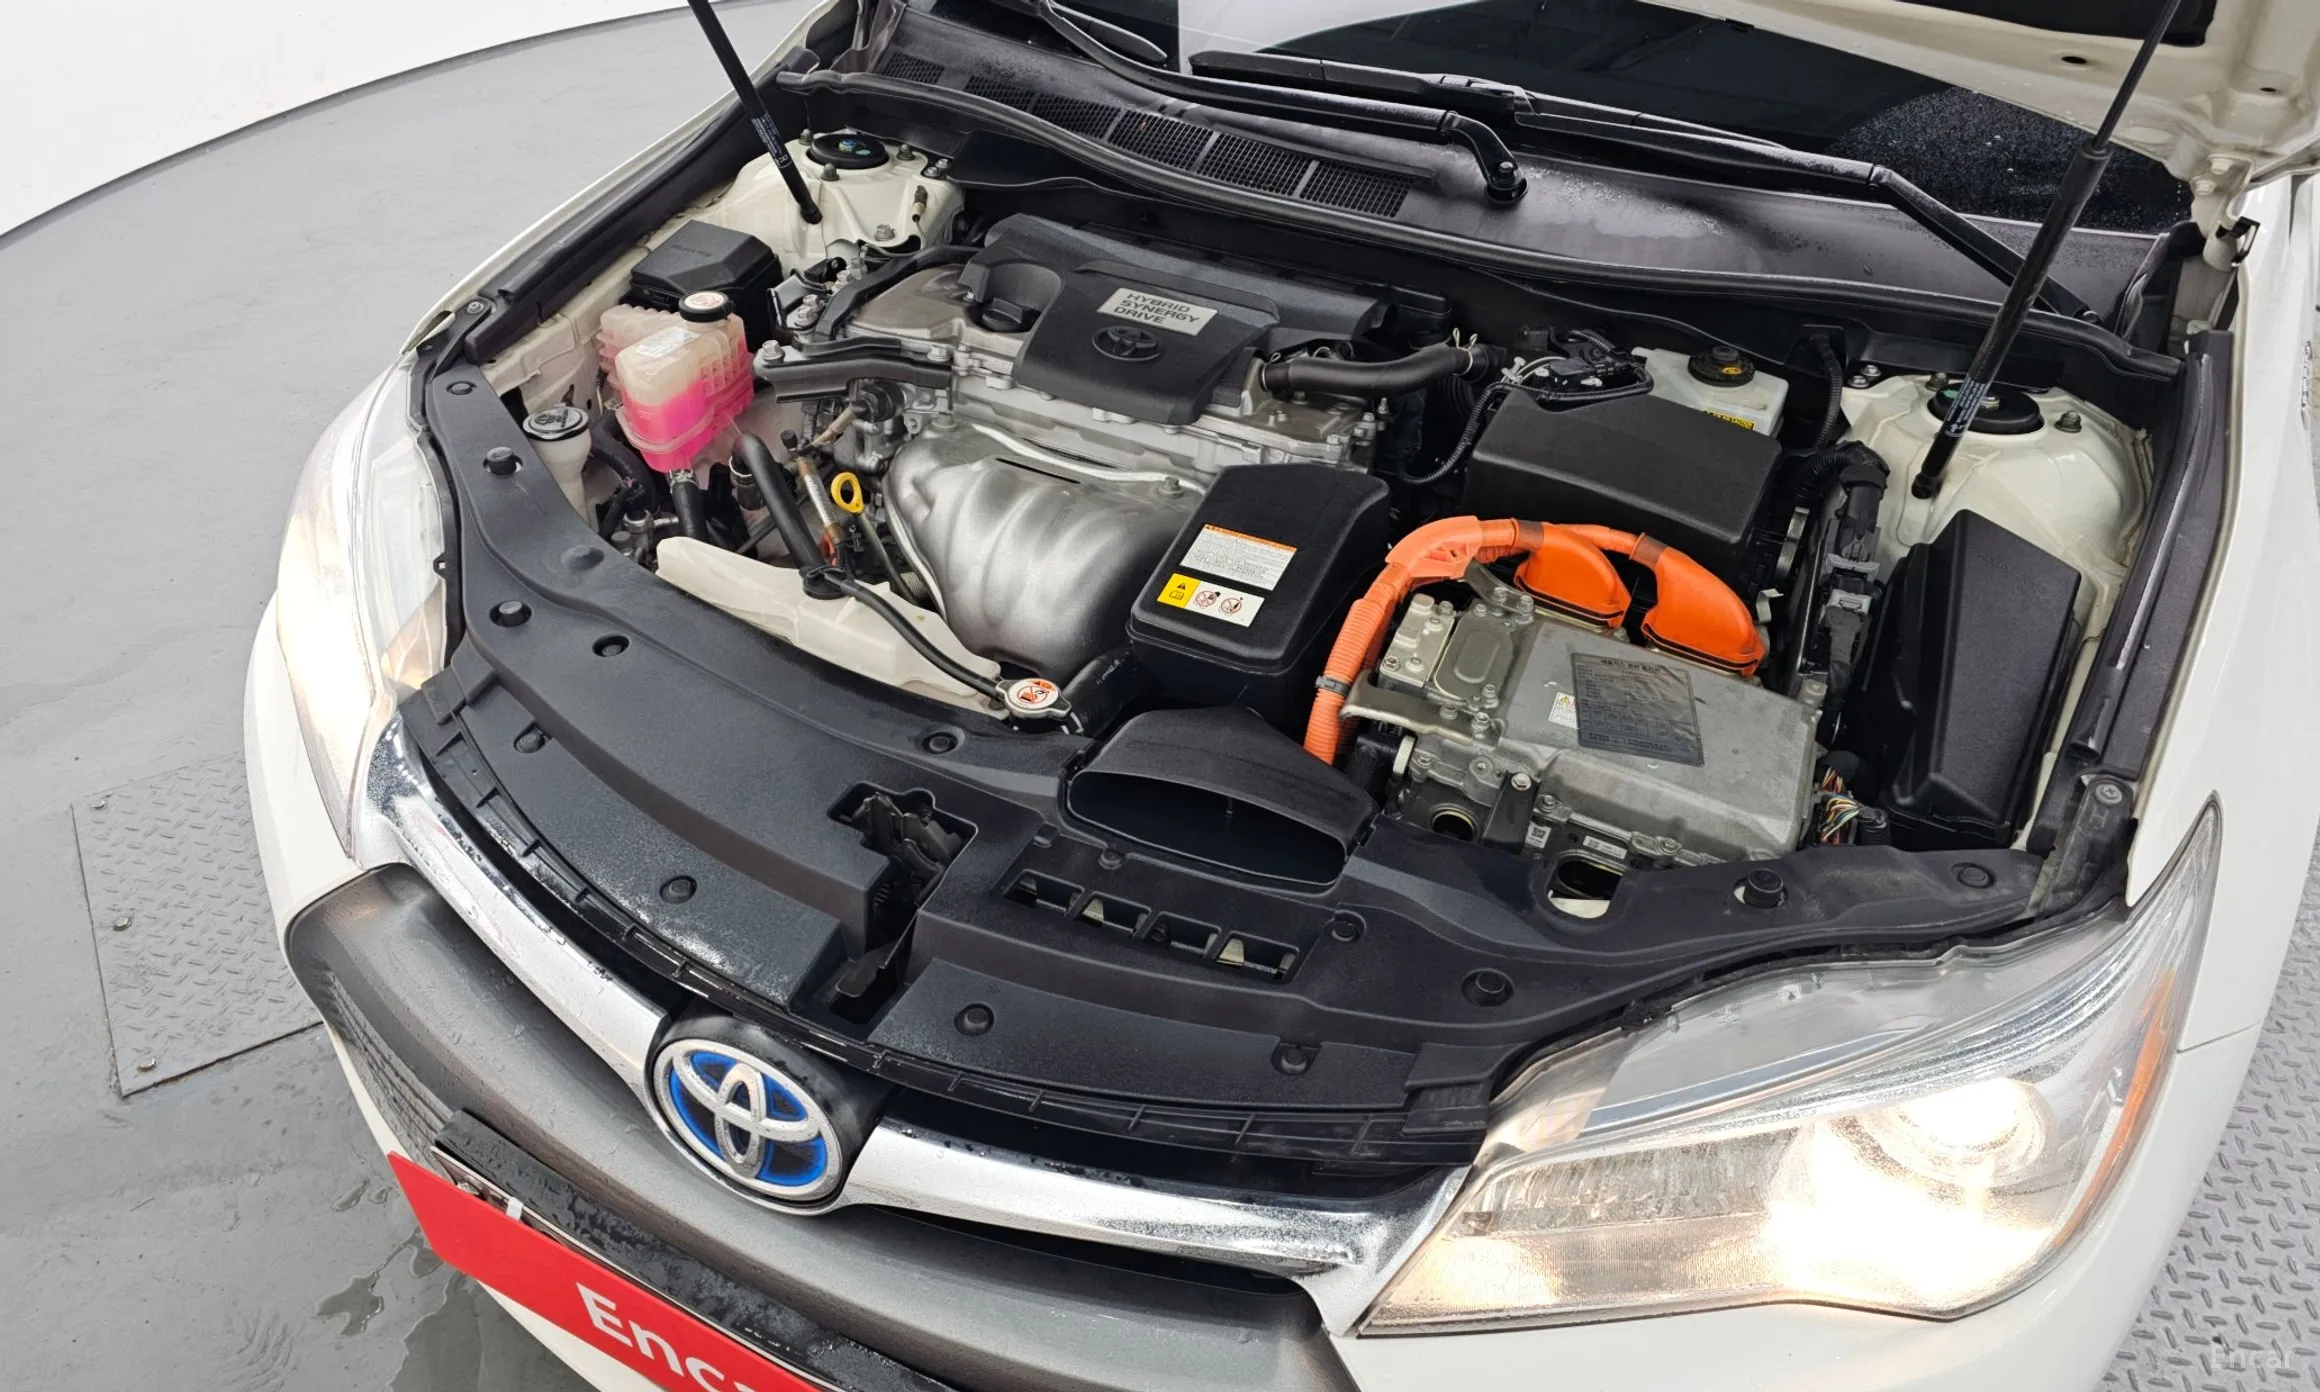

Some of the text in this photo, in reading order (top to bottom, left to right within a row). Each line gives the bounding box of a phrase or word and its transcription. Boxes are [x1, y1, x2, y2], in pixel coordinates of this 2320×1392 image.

[1120, 300, 1200, 323] SYNERGY
[1127, 293, 1191, 313] HYBRID
[1114, 306, 1166, 324] DRIVE
[576, 1282, 757, 1392] Enc
